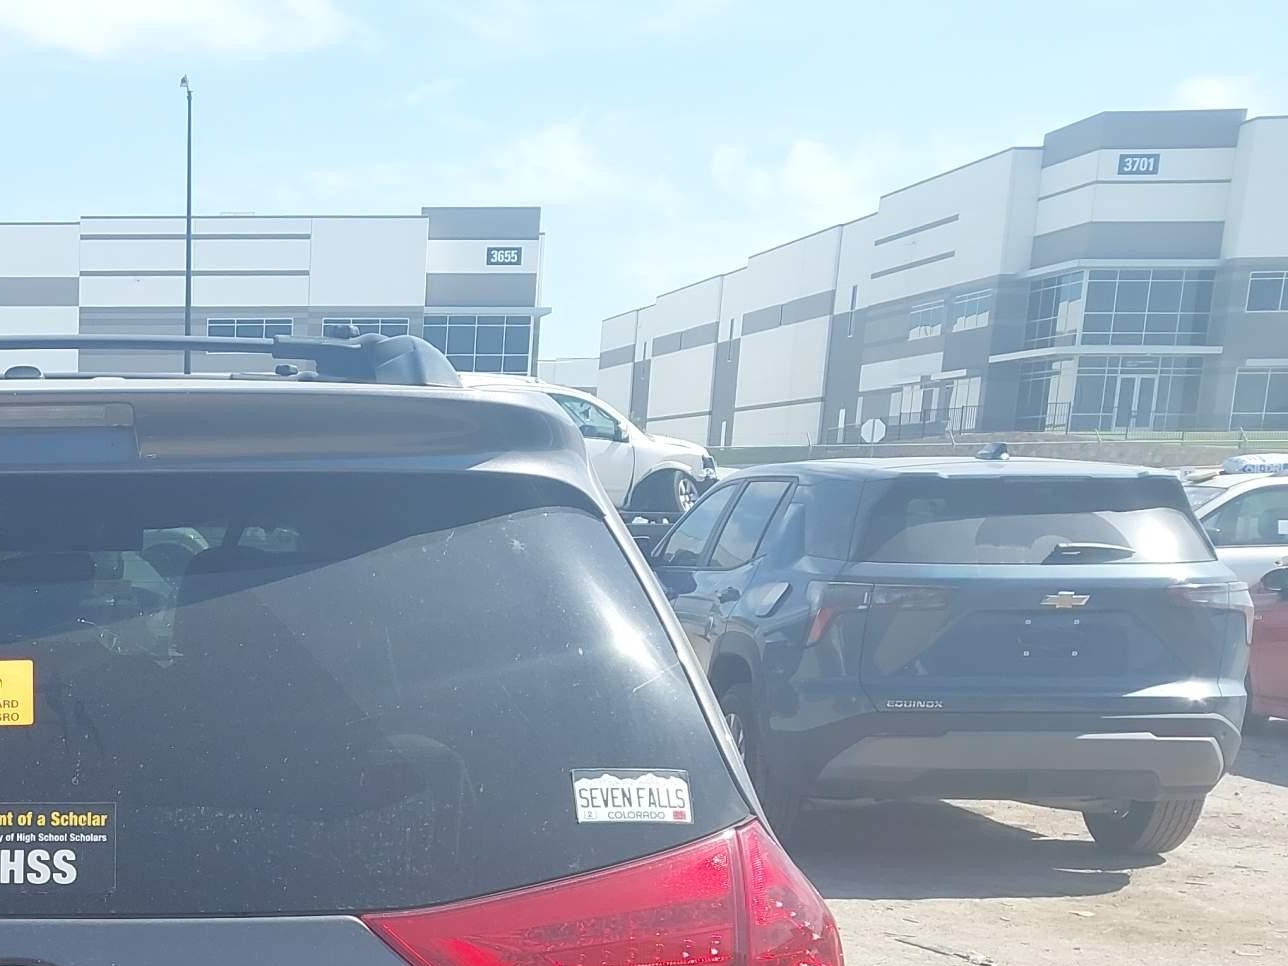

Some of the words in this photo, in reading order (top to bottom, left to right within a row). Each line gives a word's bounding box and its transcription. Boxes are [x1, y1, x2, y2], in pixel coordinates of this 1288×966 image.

[1123, 157, 1155, 172] 3701
[490, 249, 518, 263] 3655
[886, 699, 943, 708] EQUINOX
[578, 786, 633, 809] SEVEN
[636, 786, 686, 809] FALLS
[17, 811, 33, 827] of
[36, 813, 46, 827] a
[50, 811, 108, 827] Scholar
[607, 811, 666, 820] COLORADO
[5, 832, 15, 842] of
[16, 832, 37, 844] High
[38, 832, 68, 842] School
[69, 832, 108, 842] Scholars
